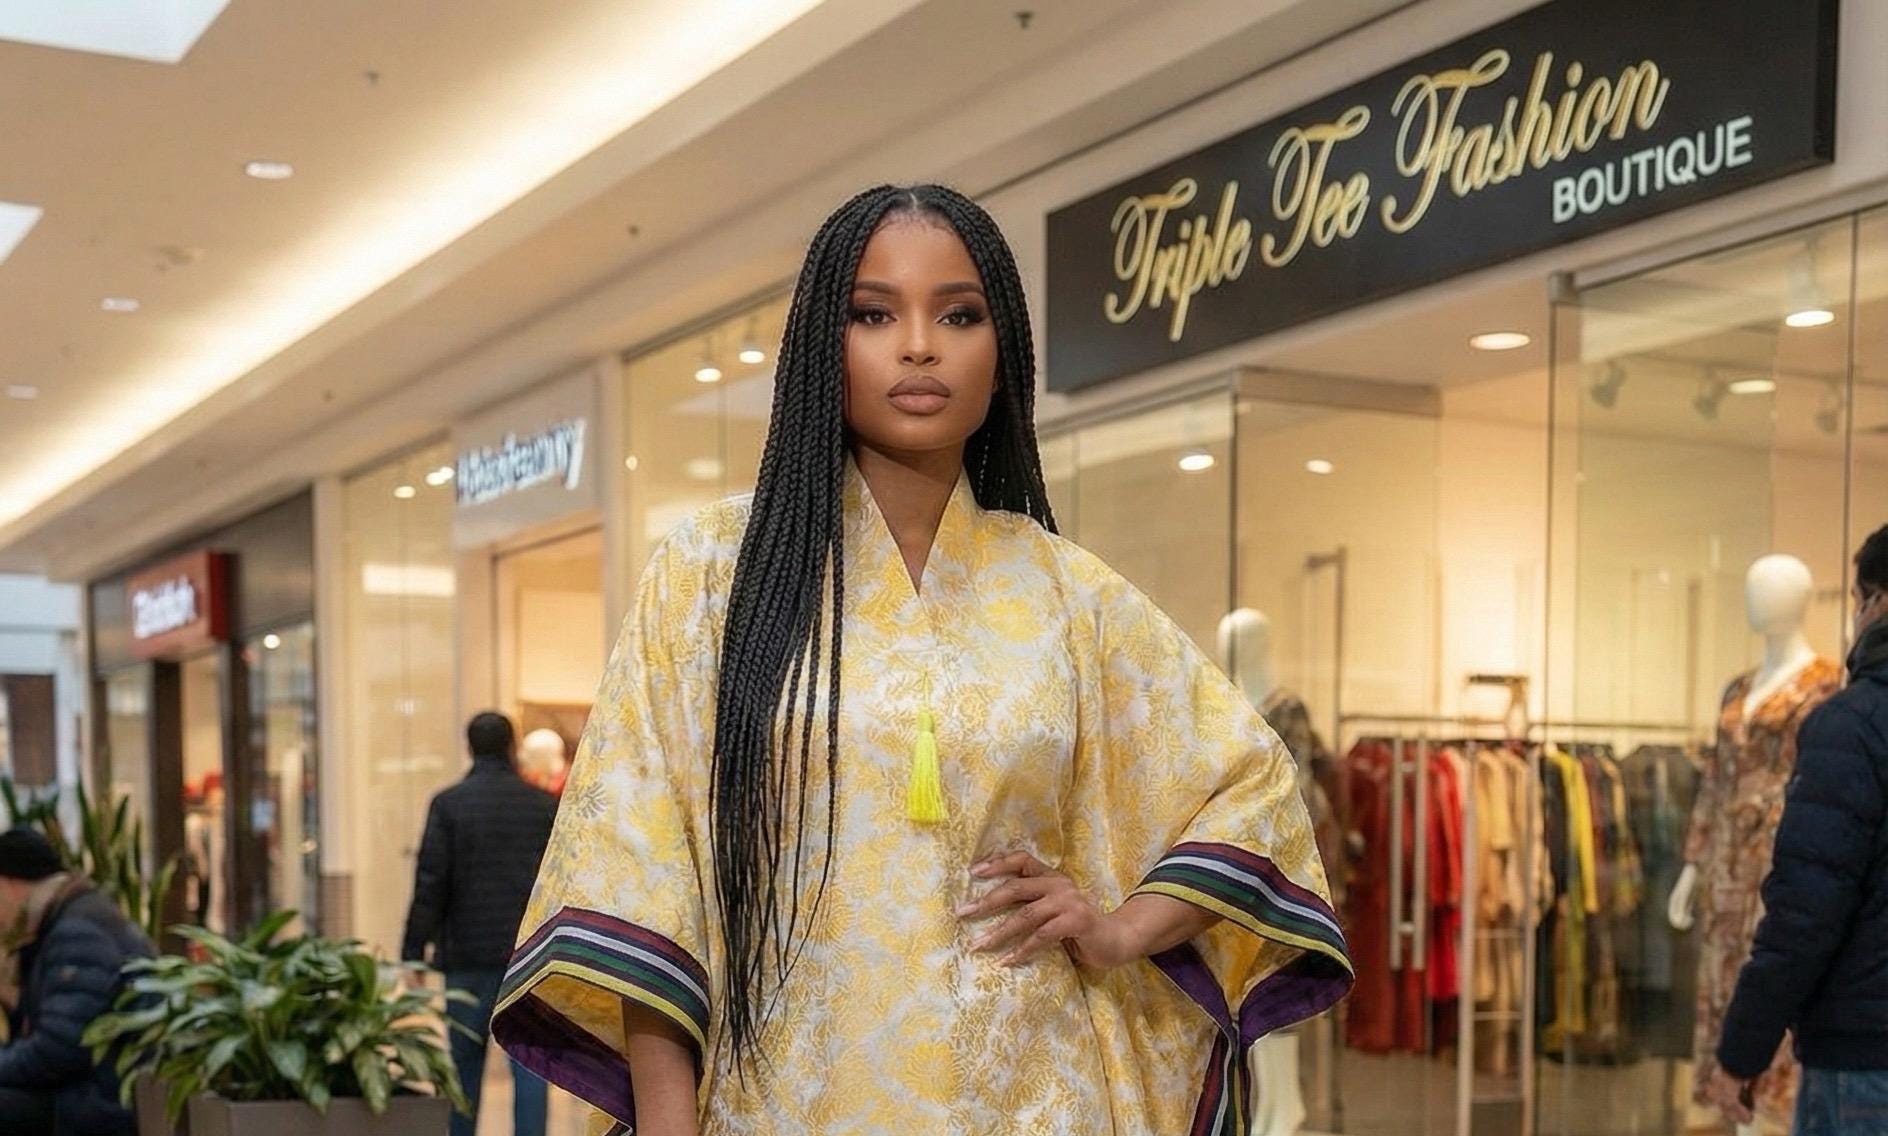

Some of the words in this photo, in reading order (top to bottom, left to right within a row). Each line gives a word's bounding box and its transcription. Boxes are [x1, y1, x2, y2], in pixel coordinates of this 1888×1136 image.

[1105, 178, 1250, 341] Triple
[1262, 105, 1371, 267] Tee
[1383, 49, 1670, 234] Fashion
[1552, 116, 1752, 223] BOUTIQUE
